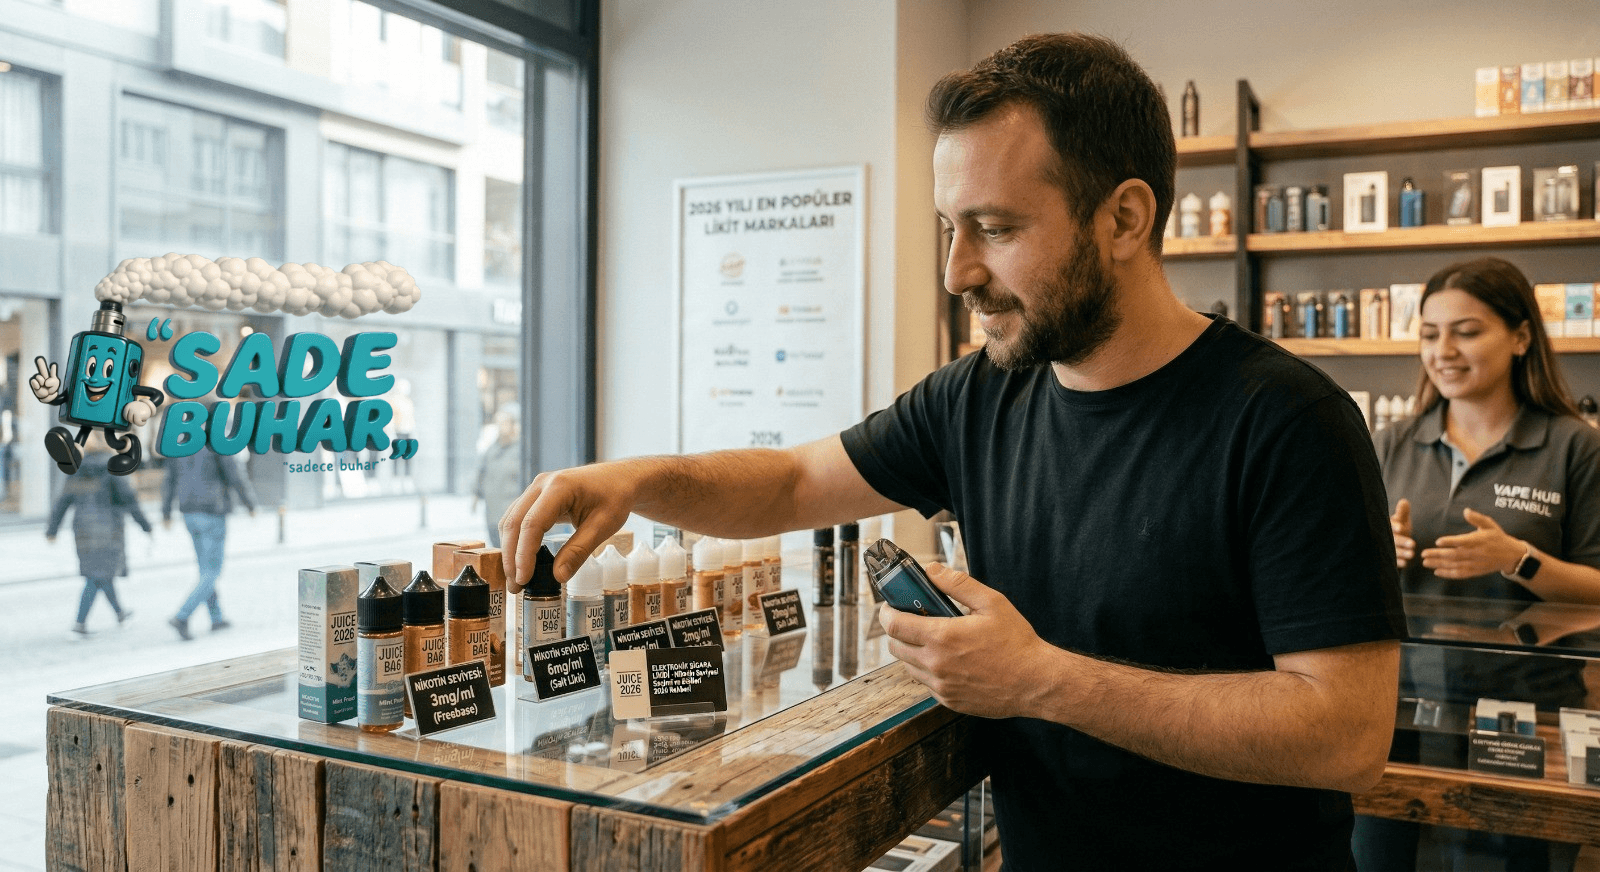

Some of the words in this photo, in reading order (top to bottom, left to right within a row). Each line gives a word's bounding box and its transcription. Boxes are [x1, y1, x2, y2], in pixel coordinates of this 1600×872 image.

[757, 196, 776, 210] EN
[781, 188, 853, 209] POPÜLER
[745, 214, 835, 232] MARKALARI
[1493, 483, 1532, 500] VAPE
[1532, 488, 1562, 505] HUB
[331, 614, 356, 629] JUICE
[537, 608, 561, 621] JUICE
[334, 627, 355, 642] 2026
[466, 630, 490, 645] JUICE
[422, 637, 445, 652] JUICE
[378, 645, 403, 661] JUICE
[547, 656, 584, 676] 6mg/ml
[414, 675, 448, 692] NİKOTİN
[550, 675, 568, 691] (Salt
[616, 673, 643, 685] JUICE
[430, 685, 476, 707] 3mg/ml
[620, 684, 642, 695] 2026
